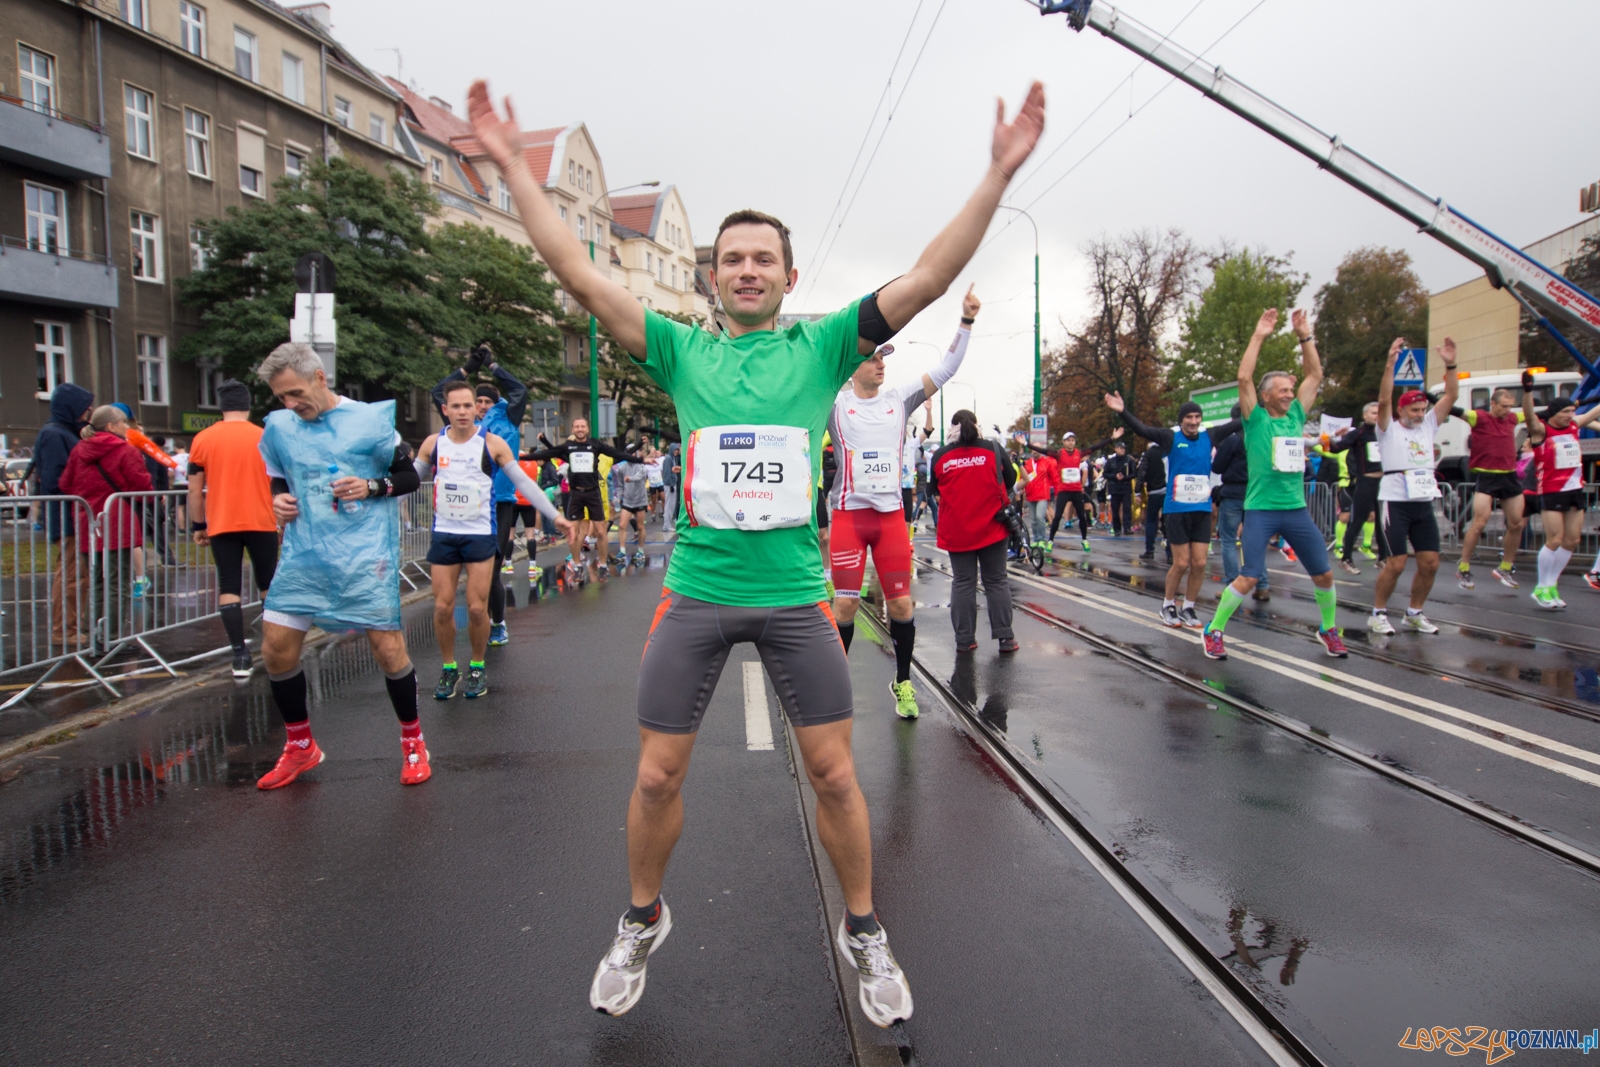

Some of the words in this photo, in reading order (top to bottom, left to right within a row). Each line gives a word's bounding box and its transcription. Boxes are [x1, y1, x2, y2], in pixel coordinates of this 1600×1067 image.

[957, 456, 987, 465] POLAND
[721, 462, 784, 484] 1743
[864, 463, 892, 474] 2461
[446, 494, 469, 504] 5710
[732, 489, 774, 500] Andrzej
